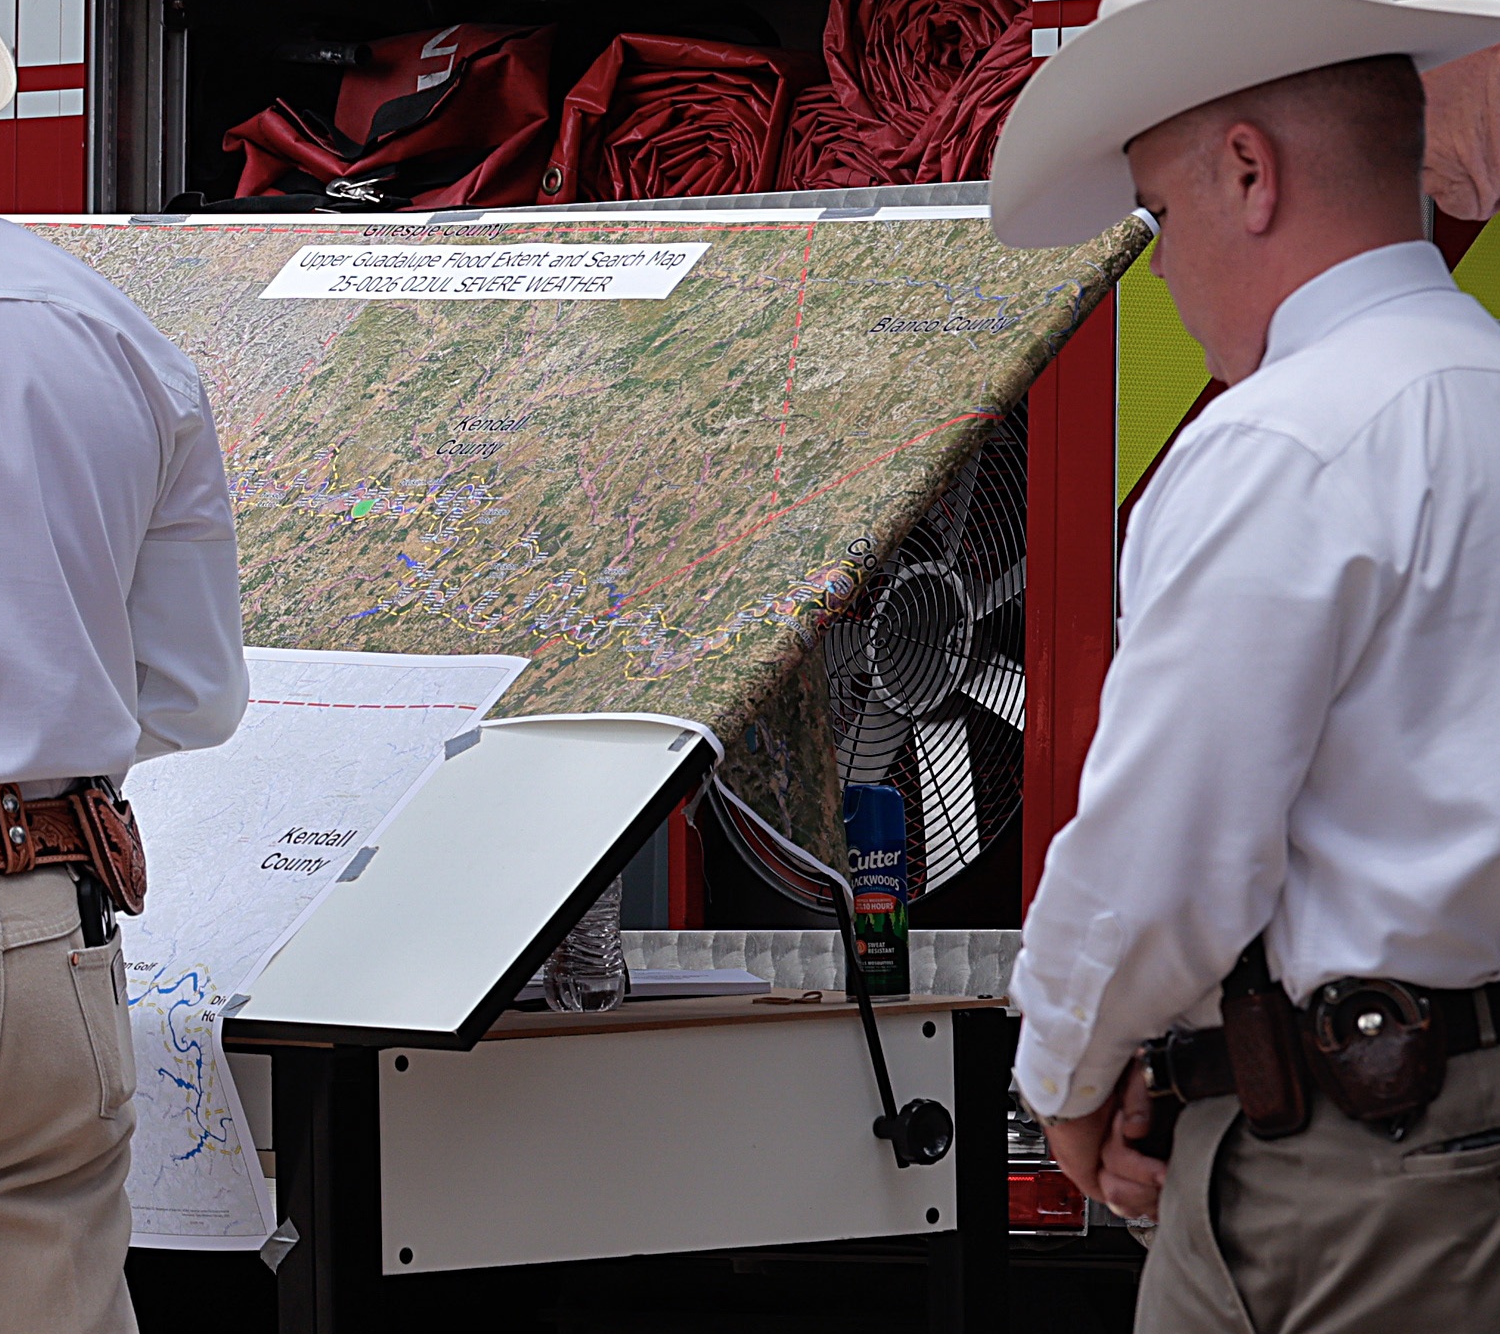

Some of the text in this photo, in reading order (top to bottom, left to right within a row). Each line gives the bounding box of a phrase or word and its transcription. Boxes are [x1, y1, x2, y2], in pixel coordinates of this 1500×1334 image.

[363, 224, 507, 240] Gillespie County
[299, 250, 687, 271] Upper Guadalupe Flood Extent and Search Map
[328, 275, 614, 293] 25-0026 02JUL SEVERE WEATHER
[870, 315, 1014, 336] Blanco County
[453, 414, 530, 433] Kendall
[435, 439, 504, 459] County
[278, 827, 358, 847] Kendall
[260, 853, 331, 876] County
[848, 848, 902, 873] Cutter
[871, 902, 894, 910] HOURS
[134, 961, 158, 972] Golf
